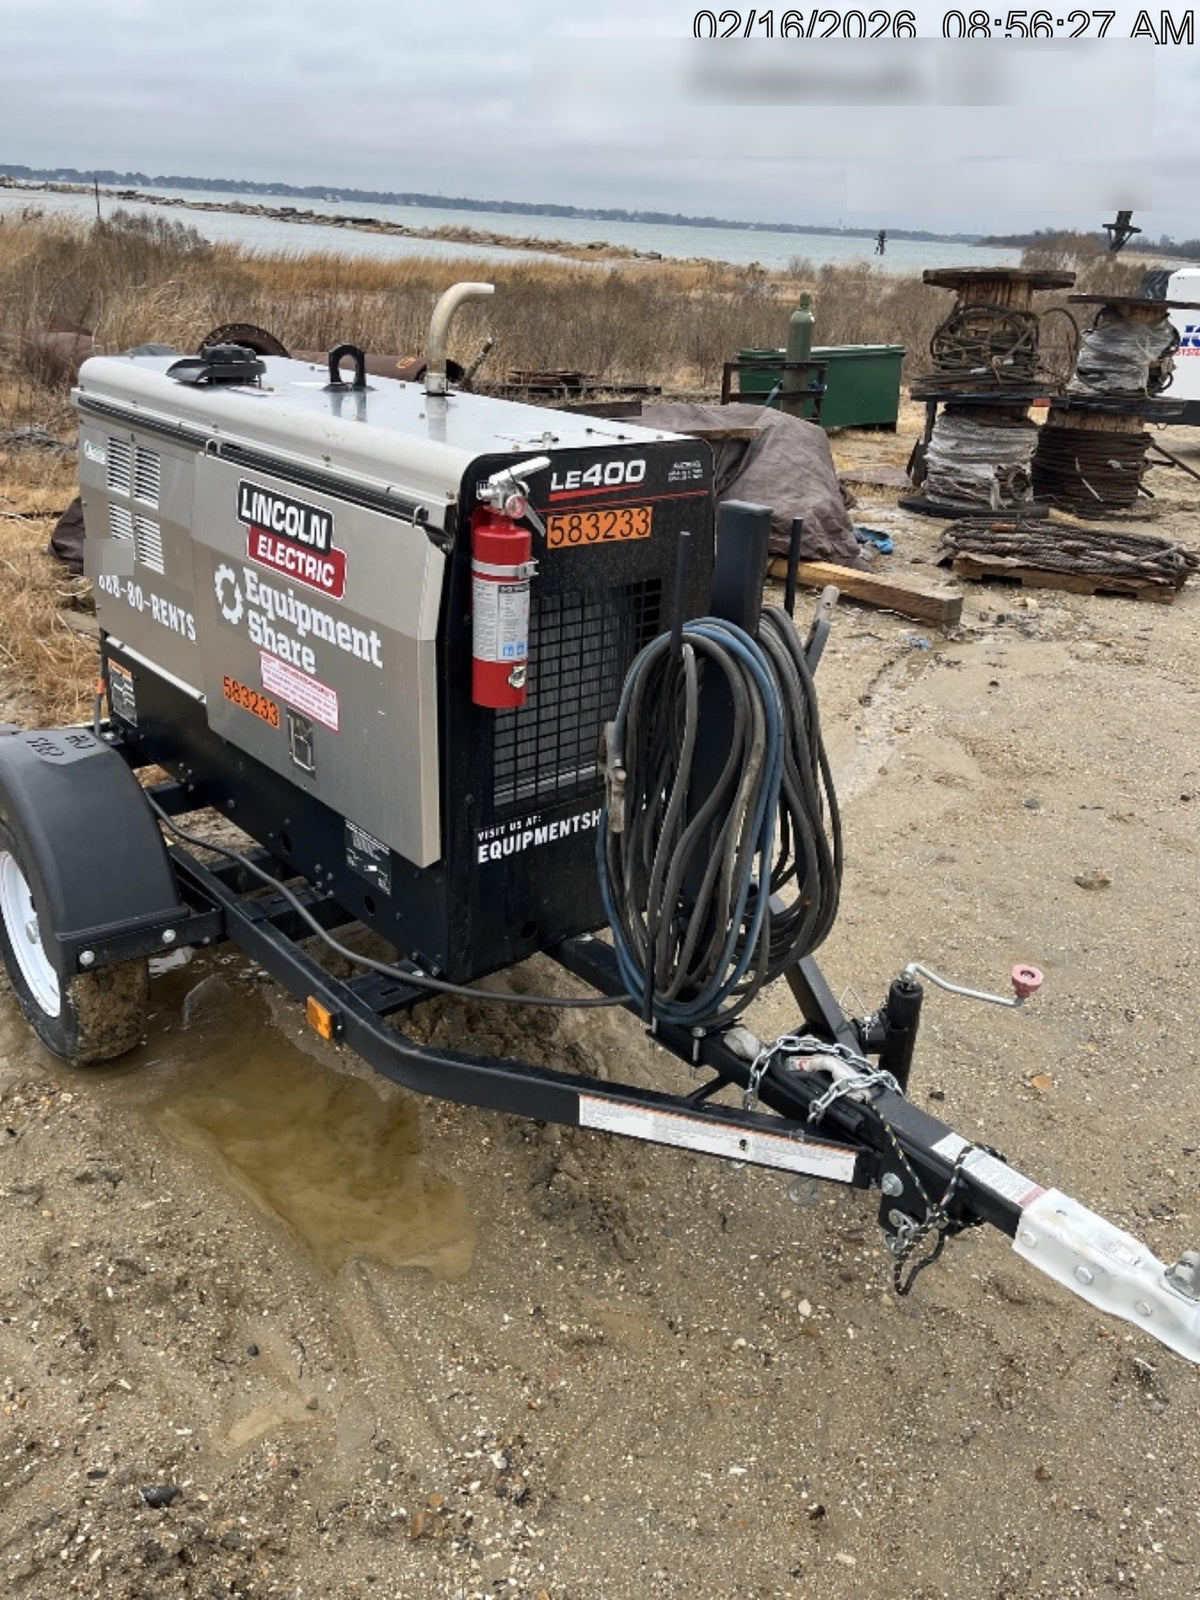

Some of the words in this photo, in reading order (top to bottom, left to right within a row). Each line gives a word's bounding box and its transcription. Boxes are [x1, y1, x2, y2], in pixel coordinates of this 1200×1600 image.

[550, 459, 646, 491] LE400
[241, 488, 328, 549] LINCOLN
[550, 507, 650, 546] 583233
[257, 534, 335, 587] ELECTRIC
[243, 566, 383, 669] Equipment
[248, 609, 316, 674] Share
[224, 675, 278, 727] 583233
[478, 825, 505, 841] VISIT
[509, 820, 522, 831] US
[526, 815, 541, 827] AT:
[478, 808, 601, 864] EQUIPMENTSH
